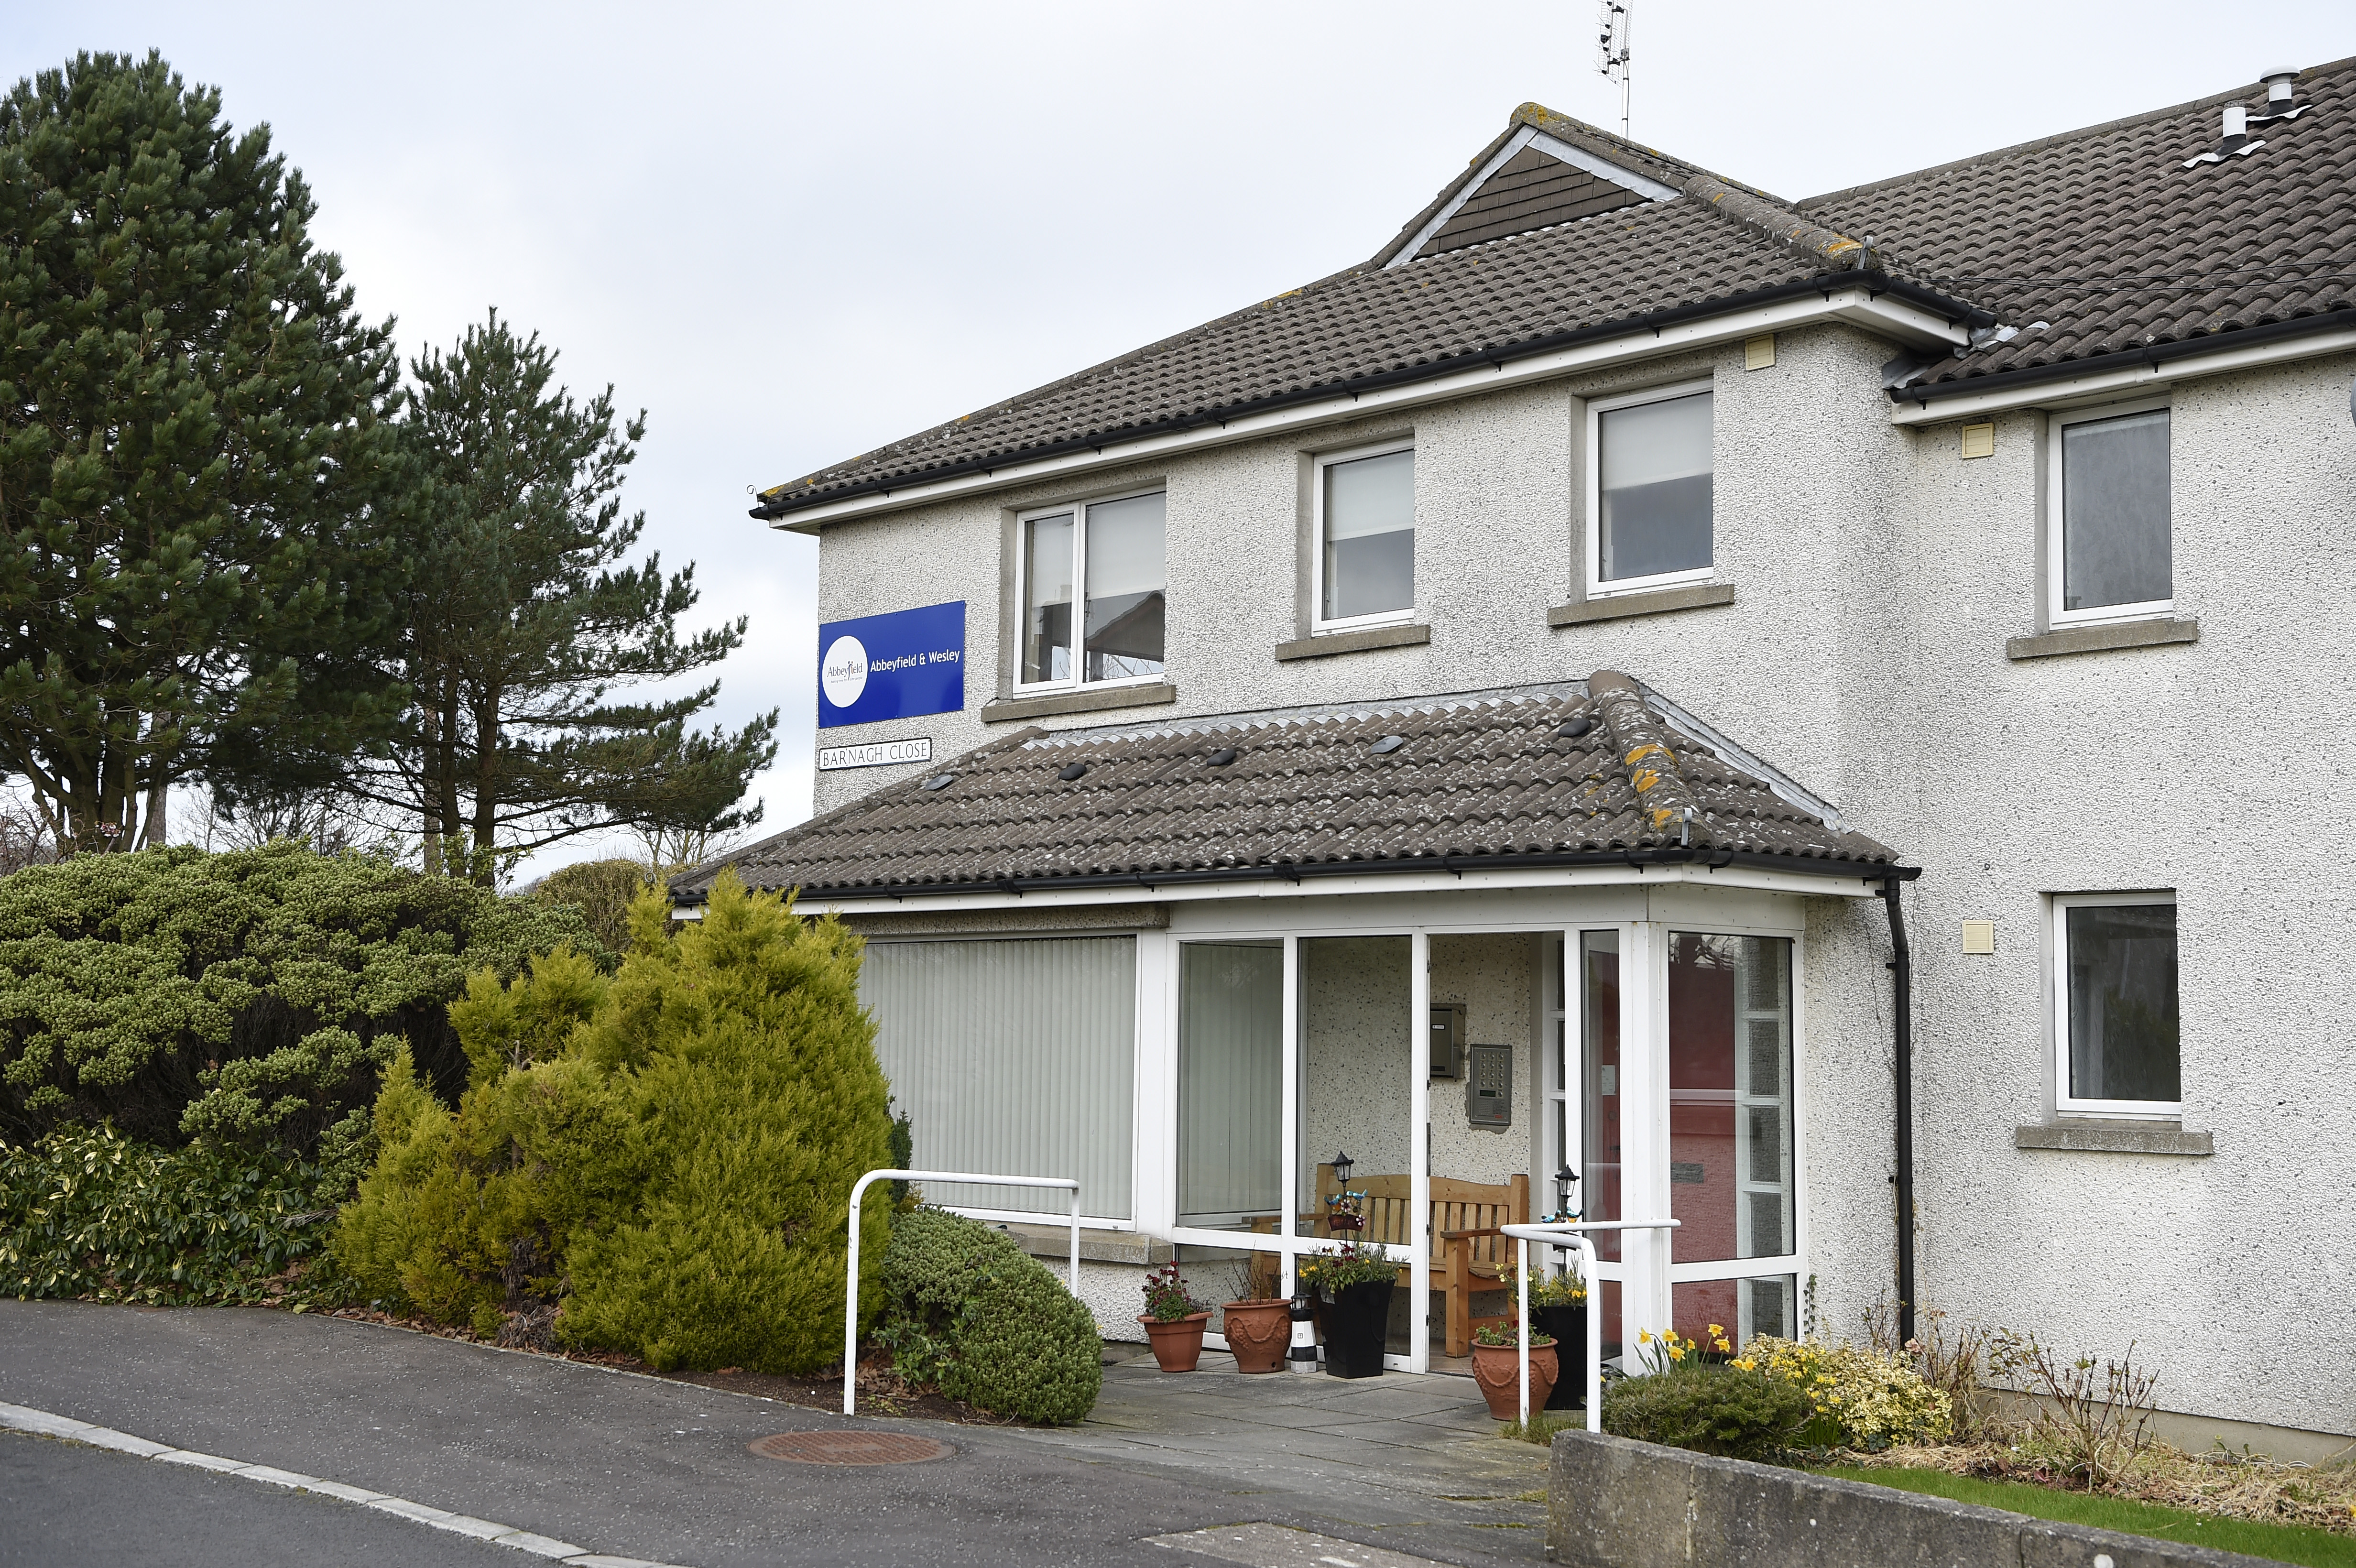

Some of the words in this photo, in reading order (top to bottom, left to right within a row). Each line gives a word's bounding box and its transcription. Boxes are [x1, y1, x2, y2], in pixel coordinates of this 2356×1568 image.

[827, 661, 863, 681] Abbeyfield
[870, 653, 916, 673] Abbeyfield
[919, 653, 926, 665] &
[928, 649, 960, 664] Wesley
[823, 747, 883, 766] BARNAGH
[890, 742, 927, 759] CLOSE
